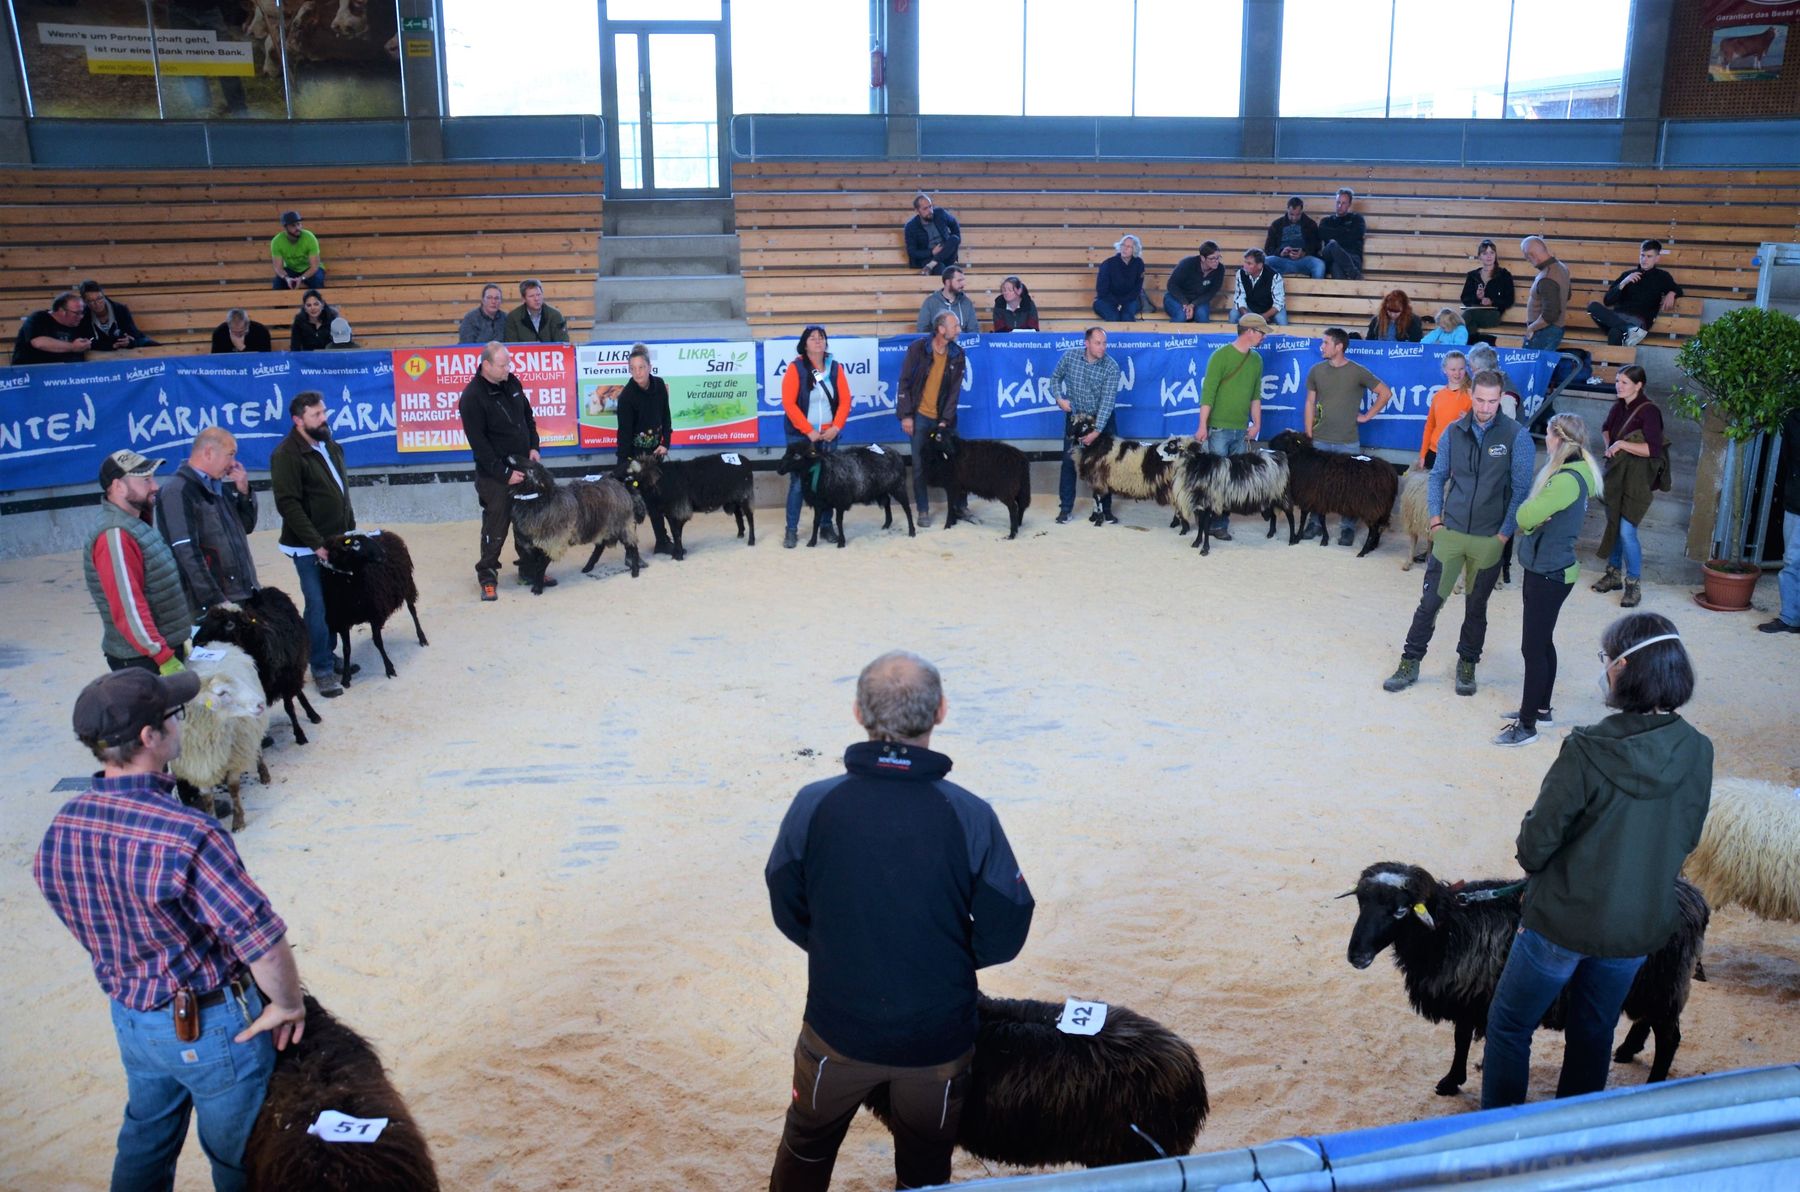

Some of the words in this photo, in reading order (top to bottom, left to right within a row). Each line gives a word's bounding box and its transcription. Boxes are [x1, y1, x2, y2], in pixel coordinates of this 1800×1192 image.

[47, 30, 87, 39] Wenn's
[185, 36, 210, 44] geht,
[185, 48, 216, 56] meine
[989, 339, 1051, 349] www.kaernten.at
[598, 350, 630, 362] LIKR
[435, 351, 565, 376] HARSSNER
[706, 359, 734, 372] San
[177, 368, 248, 376] www.kaernten.at
[301, 367, 369, 375] www.kaernten.at
[522, 371, 567, 382] ZUKUNFT
[43, 374, 121, 387] www.kaernten.at
[703, 380, 723, 389] regt
[724, 379, 738, 387] die
[400, 392, 431, 410] IHR
[539, 387, 566, 404] BEI
[687, 390, 734, 399] Verdauung
[402, 429, 471, 448] HEIZUN
[730, 432, 755, 440] füttern
[1071, 1006, 1093, 1027] 42
[333, 1121, 371, 1135] 51
